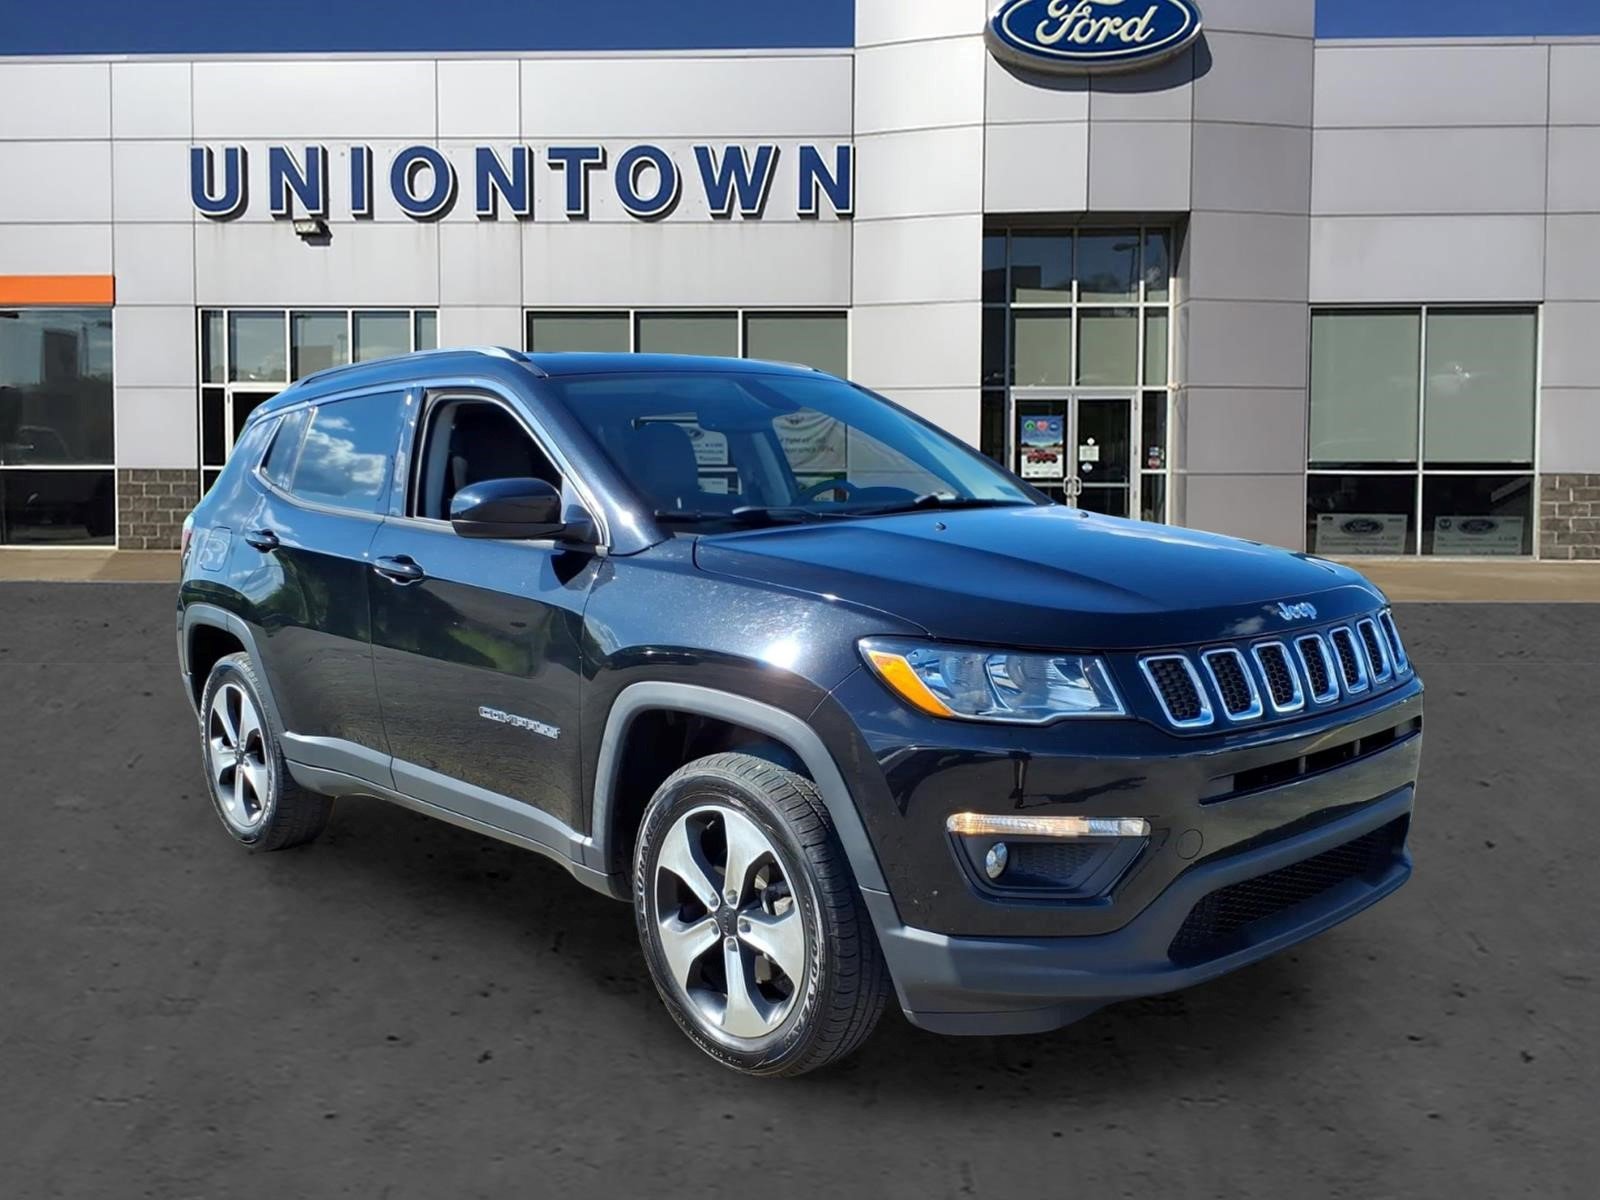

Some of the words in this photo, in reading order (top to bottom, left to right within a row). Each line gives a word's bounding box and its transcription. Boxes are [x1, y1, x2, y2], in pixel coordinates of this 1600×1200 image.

[1035, 0, 1158, 44] Ford
[190, 144, 852, 218] UNIONTOWN
[1277, 602, 1317, 620] Jeep
